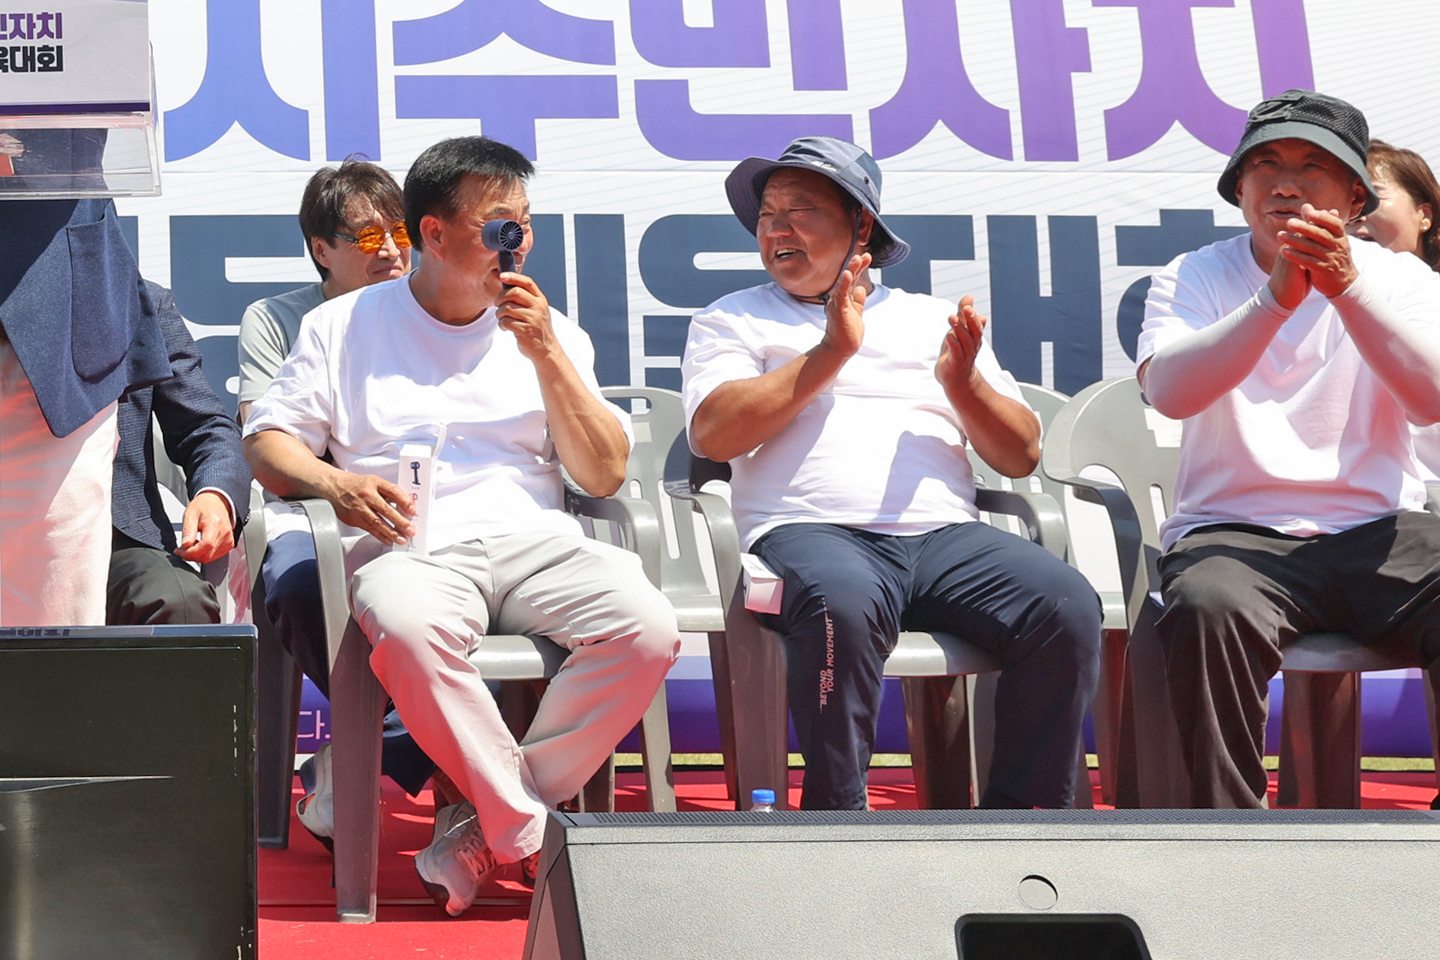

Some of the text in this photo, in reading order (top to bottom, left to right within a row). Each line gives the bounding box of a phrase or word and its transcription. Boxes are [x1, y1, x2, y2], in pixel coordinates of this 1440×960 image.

[825, 618, 835, 693] YOUR MOVEMENT
[819, 669, 827, 706] BEYOND
